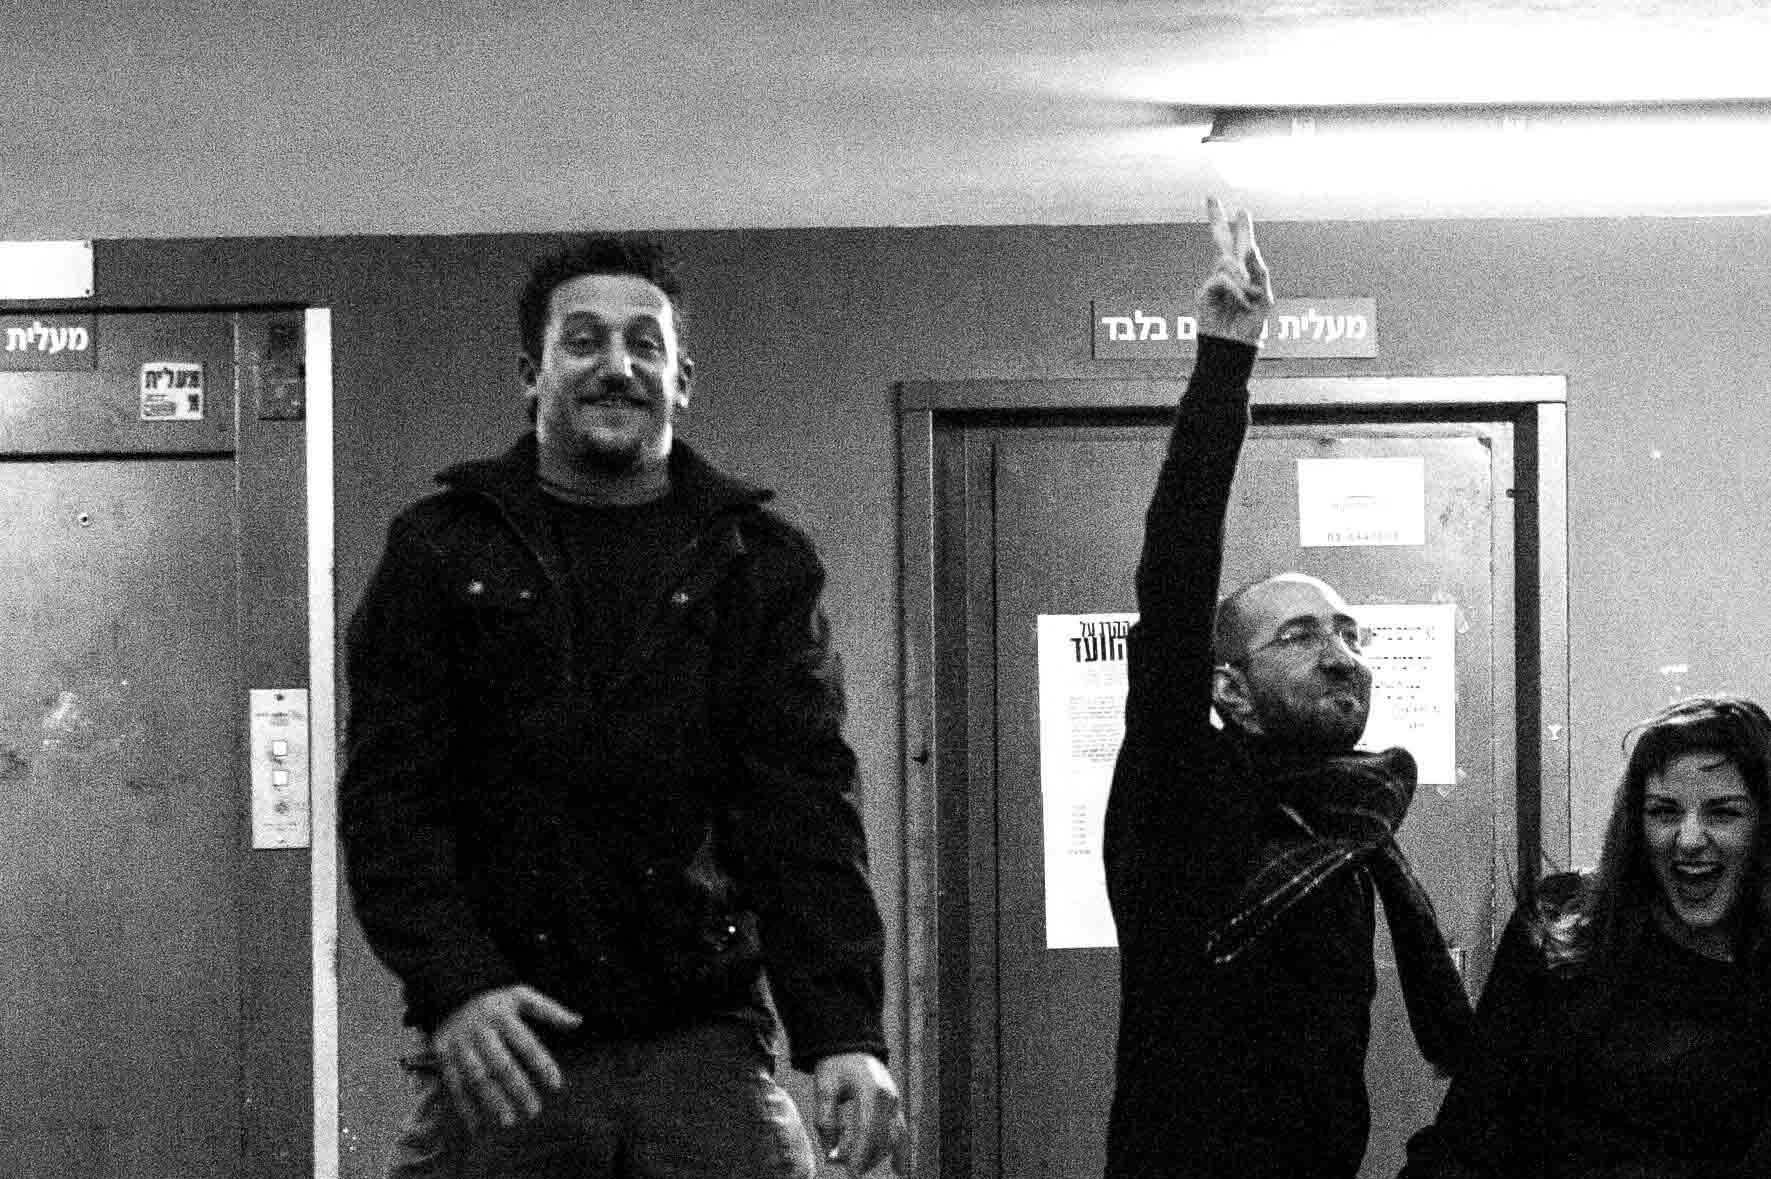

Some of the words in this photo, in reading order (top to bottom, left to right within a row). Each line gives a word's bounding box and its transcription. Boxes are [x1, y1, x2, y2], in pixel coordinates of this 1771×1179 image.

[6, 321, 89, 354] מעלית
[1101, 310, 1169, 341] בלבד
[1278, 309, 1369, 342] מעלית
